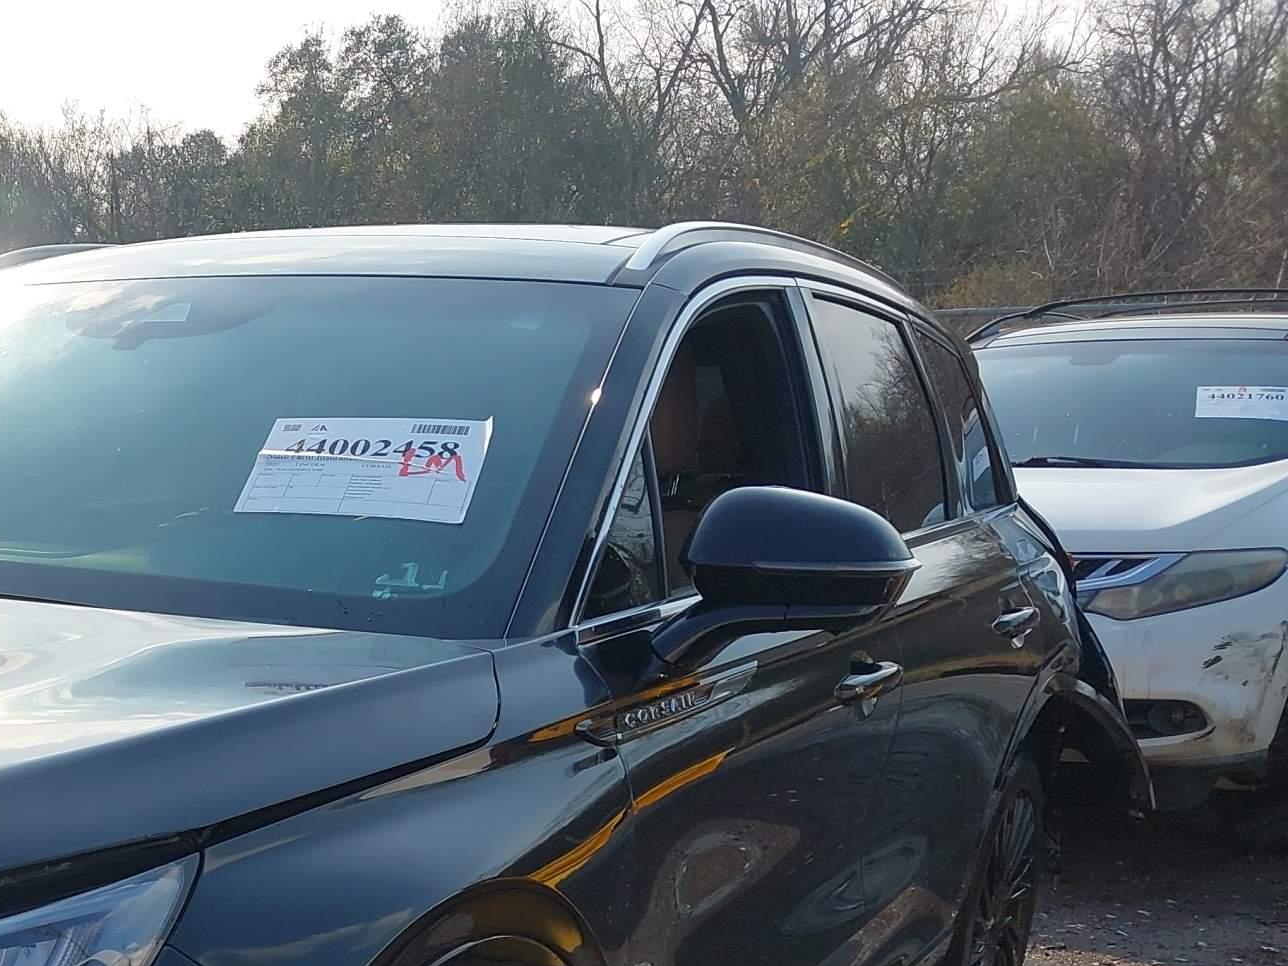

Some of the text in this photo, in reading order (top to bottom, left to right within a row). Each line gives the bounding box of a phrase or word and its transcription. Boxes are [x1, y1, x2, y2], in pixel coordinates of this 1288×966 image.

[1207, 393, 1285, 401] 44021760
[284, 438, 460, 460] 44002458
[624, 690, 696, 729] CORSAIR
